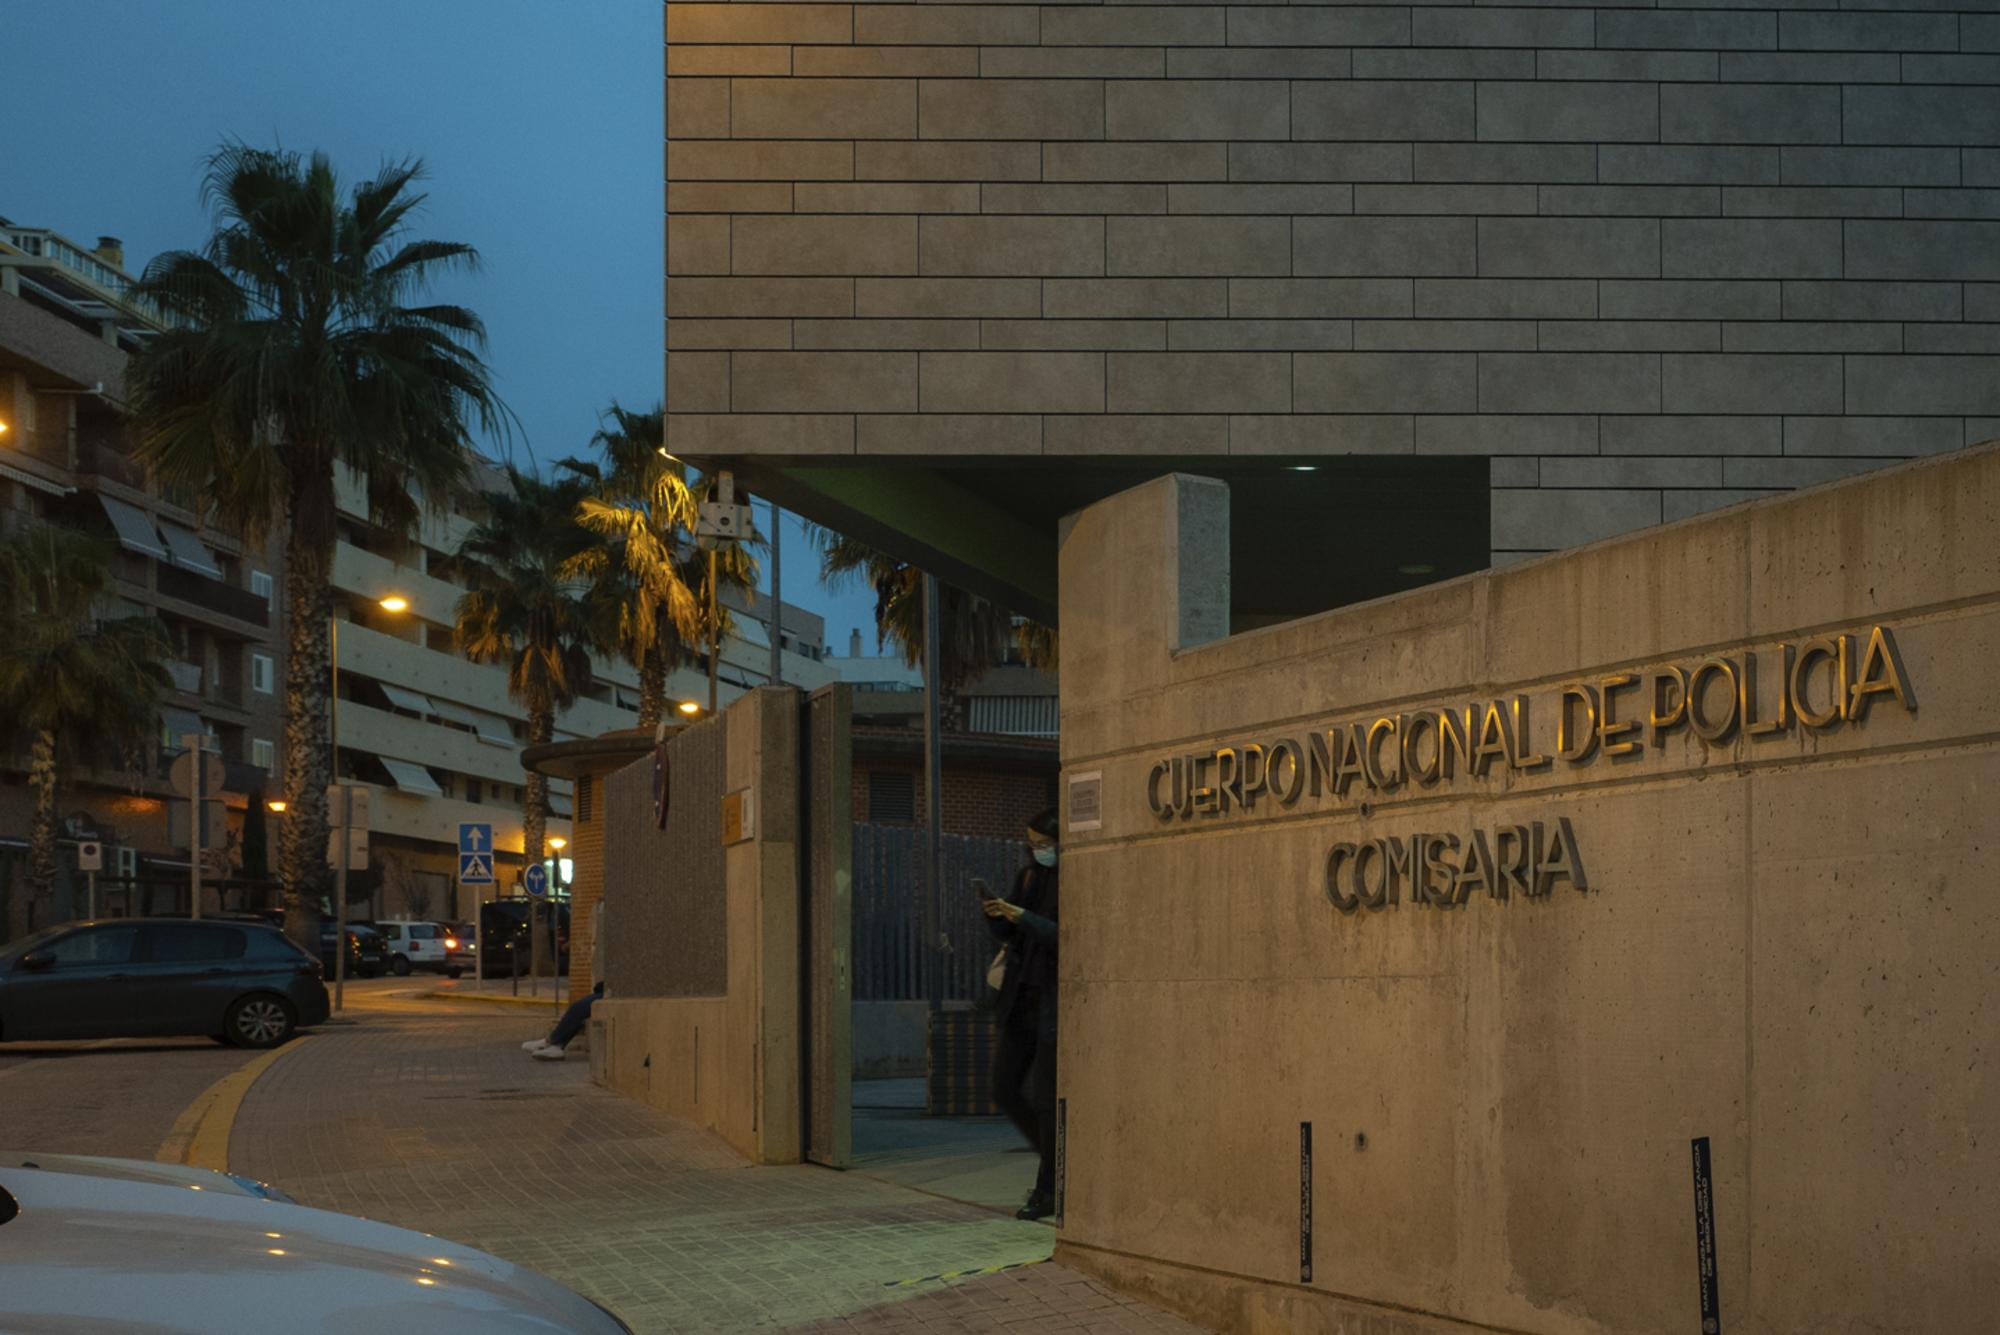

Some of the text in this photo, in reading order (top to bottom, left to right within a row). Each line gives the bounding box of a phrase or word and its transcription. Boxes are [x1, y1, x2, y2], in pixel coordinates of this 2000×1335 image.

[1148, 626, 1917, 822] CUERPO NACIONAL DE POLICIA
[1324, 817, 1587, 913] COMISARIA
